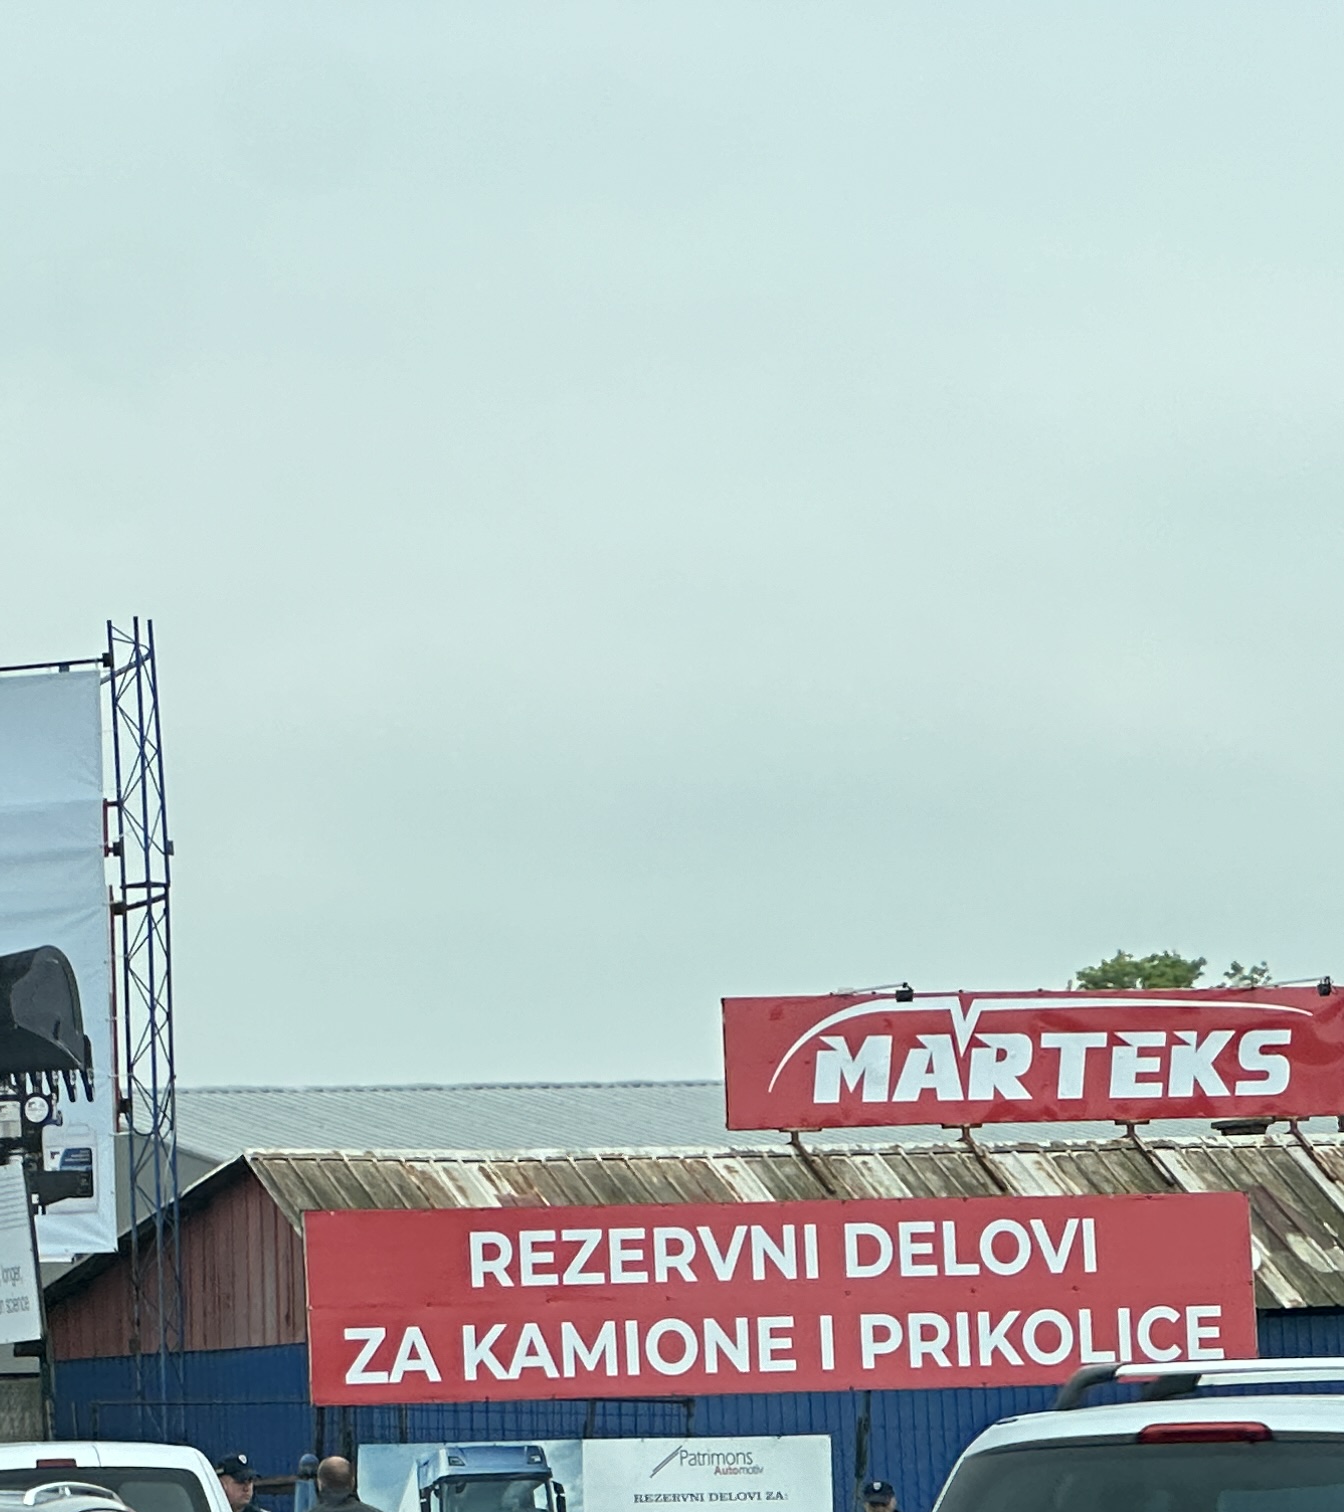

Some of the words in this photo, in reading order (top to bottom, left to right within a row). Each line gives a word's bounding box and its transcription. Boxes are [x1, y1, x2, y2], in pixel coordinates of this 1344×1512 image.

[813, 1028, 1293, 1105] MARTEKS
[468, 1222, 820, 1289] REZERVNI
[842, 1216, 1099, 1280] DELOVI
[342, 1324, 443, 1386] ZA
[461, 1314, 798, 1382] KAMIONE
[818, 1313, 836, 1372] I
[858, 1303, 1226, 1371] PRIKOLICE
[679, 1450, 754, 1467] Patrimons
[714, 1465, 764, 1476] Automotiv
[633, 1493, 705, 1504] REZERVNI
[709, 1491, 762, 1502] DELOVI
